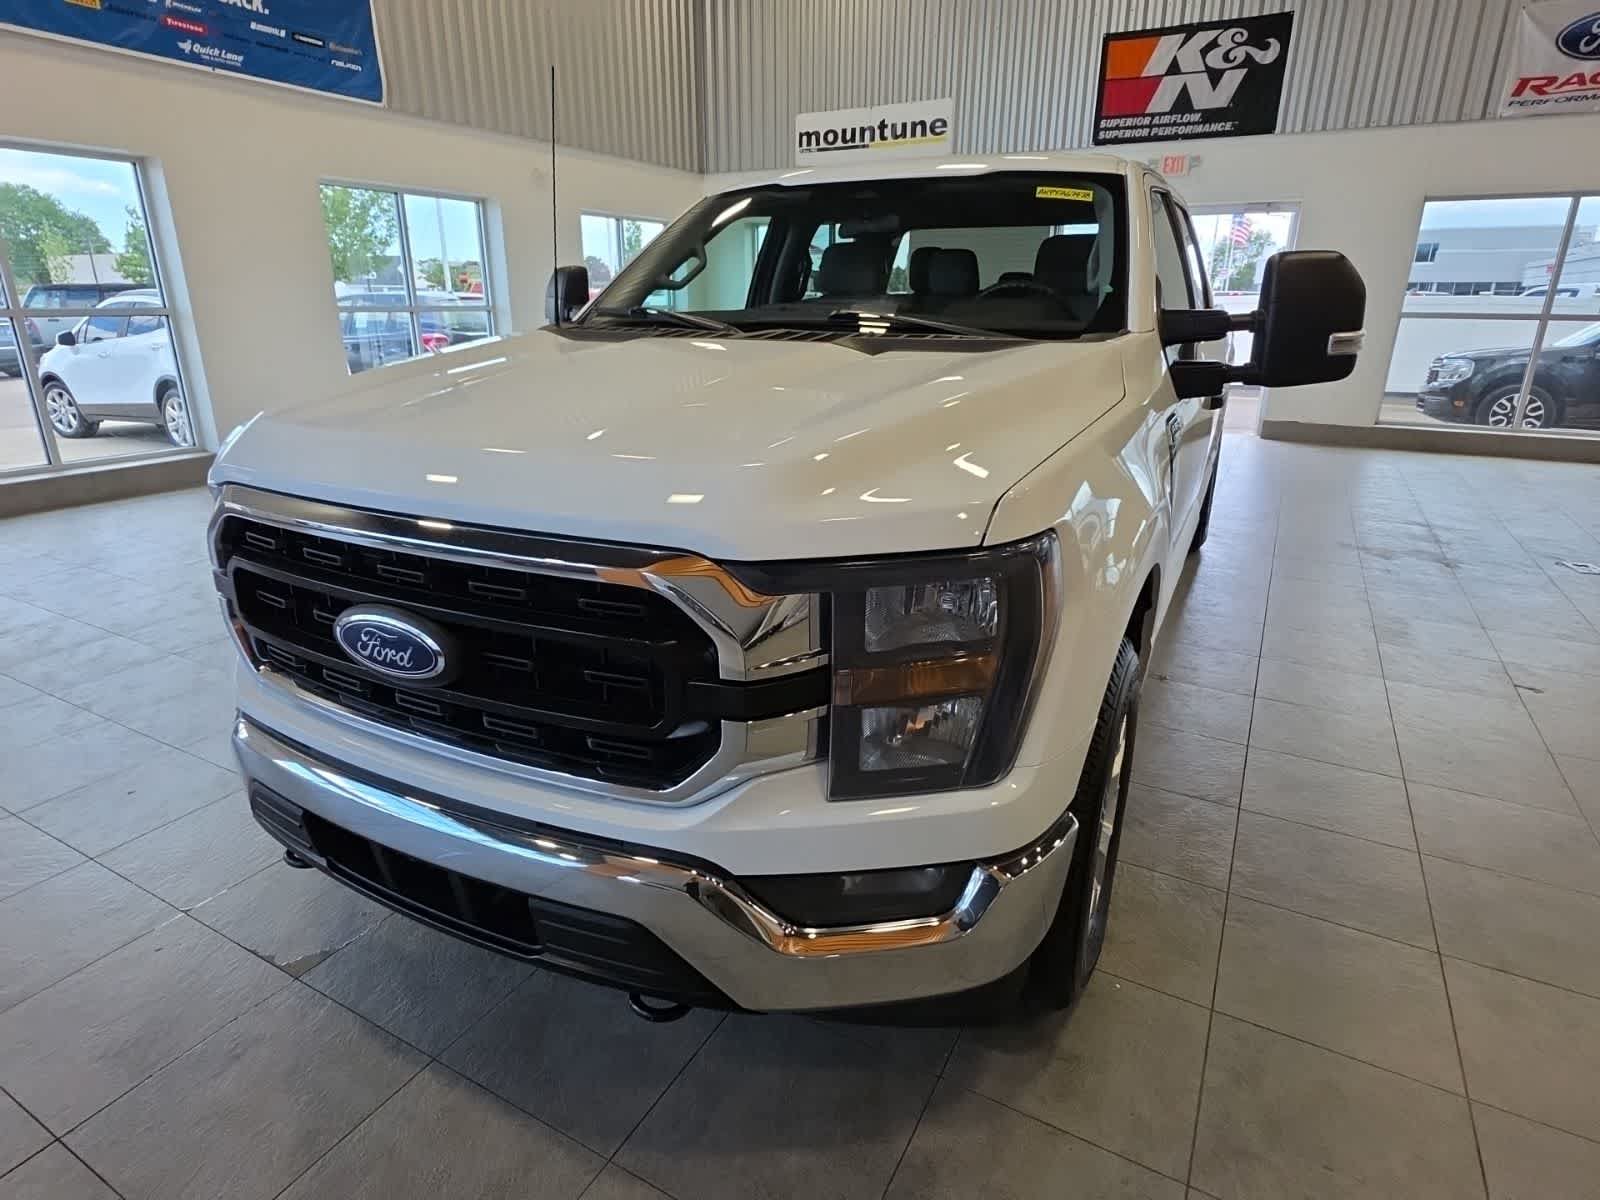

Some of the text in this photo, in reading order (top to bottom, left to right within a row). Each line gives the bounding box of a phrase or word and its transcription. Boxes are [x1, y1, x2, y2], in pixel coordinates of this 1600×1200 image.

[193, 43, 220, 56] Quick
[221, 50, 244, 62] Lane
[1100, 112, 1203, 128] SUPERIOR AIRFLOW.
[798, 117, 948, 148] mountune
[1099, 121, 1235, 140] SUPERIOR PERFORMANCE.
[1163, 155, 1185, 173] EXIT
[357, 627, 414, 668] Ford
